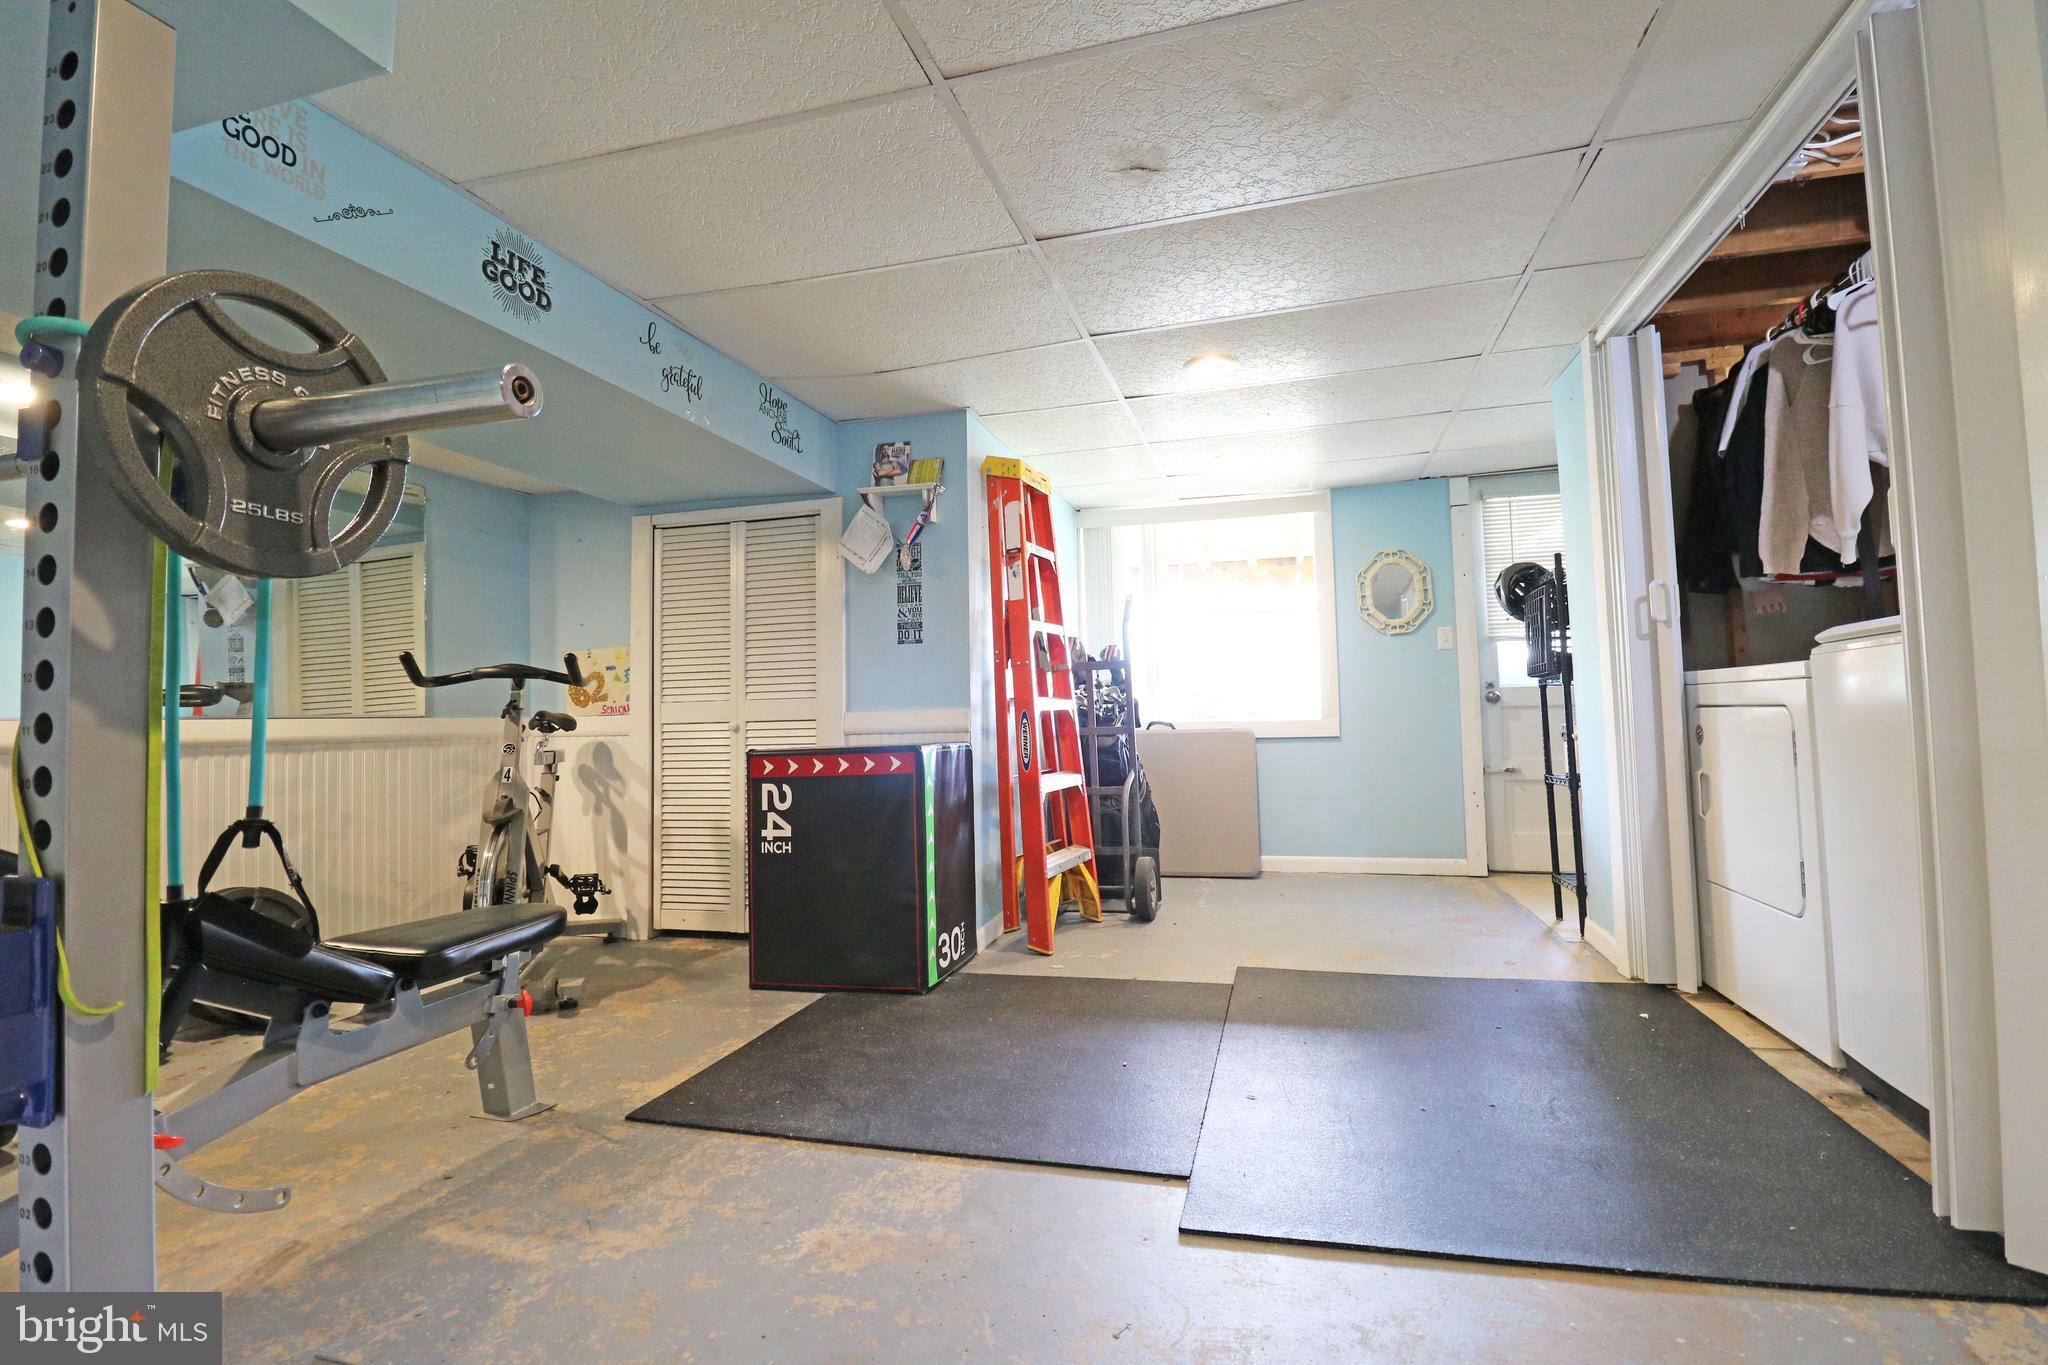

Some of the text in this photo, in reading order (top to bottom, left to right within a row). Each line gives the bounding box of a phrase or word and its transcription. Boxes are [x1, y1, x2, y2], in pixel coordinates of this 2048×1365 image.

[222, 116, 297, 168] GOOD
[264, 160, 326, 201] WORLD
[36, 262, 47, 273] 20
[490, 240, 546, 290] LIFE
[482, 259, 552, 312] GOOD
[639, 321, 662, 355] be
[207, 366, 287, 420] FITNESS
[661, 365, 703, 403] grateful
[759, 382, 788, 417] Hope
[772, 422, 800, 451] Soul
[230, 499, 304, 524] 25LBS
[898, 629, 922, 640] DO IT
[23, 671, 34, 683] 12
[504, 767, 511, 782] 4
[761, 783, 792, 841] 24
[761, 841, 792, 854] INCH
[504, 870, 518, 905] SPINNI
[938, 926, 961, 968] 30
[18, 1153, 30, 1166] 03
[19, 1207, 30, 1220] 02
[20, 1260, 31, 1273] 01
